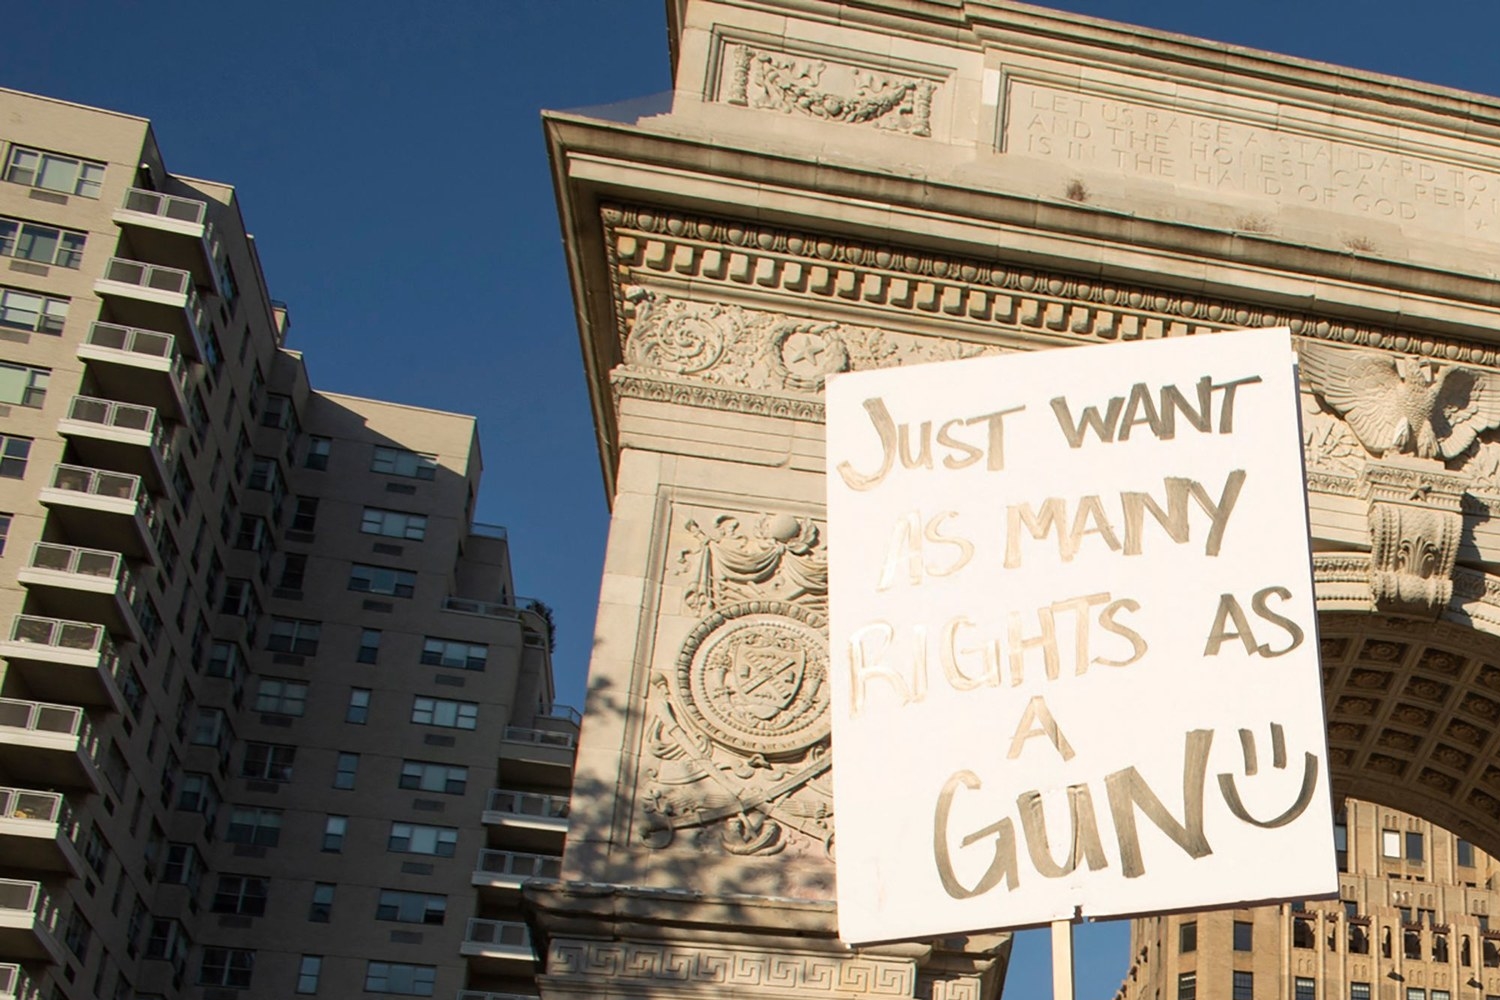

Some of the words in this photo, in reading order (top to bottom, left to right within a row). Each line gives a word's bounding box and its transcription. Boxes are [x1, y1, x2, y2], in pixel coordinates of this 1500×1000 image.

[1027, 114, 1091, 140] AND
[1106, 126, 1169, 154] THE
[1189, 141, 1314, 181] HONEST
[1333, 169, 1399, 195] CAN
[1028, 134, 1051, 155] IS
[1067, 141, 1096, 160] IN
[1111, 149, 1175, 177] THE
[1193, 163, 1281, 196] HAND
[1298, 184, 1338, 205] OF
[1353, 193, 1417, 221] GOD
[1031, 90, 1090, 118] LET
[1102, 104, 1134, 126] US
[1146, 112, 1232, 145] RAISE
[1245, 131, 1258, 147] A
[1278, 136, 1436, 183] STANDARD
[1449, 170, 1487, 192] TO
[836, 397, 1026, 492] JUST
[1050, 375, 1263, 448] WANT
[876, 509, 974, 593] AS
[1003, 469, 1247, 570] MANY
[847, 592, 1149, 719] RIGHTS
[1203, 586, 1305, 659] AS
[1006, 695, 1076, 762] A
[933, 729, 1215, 900] GUN
